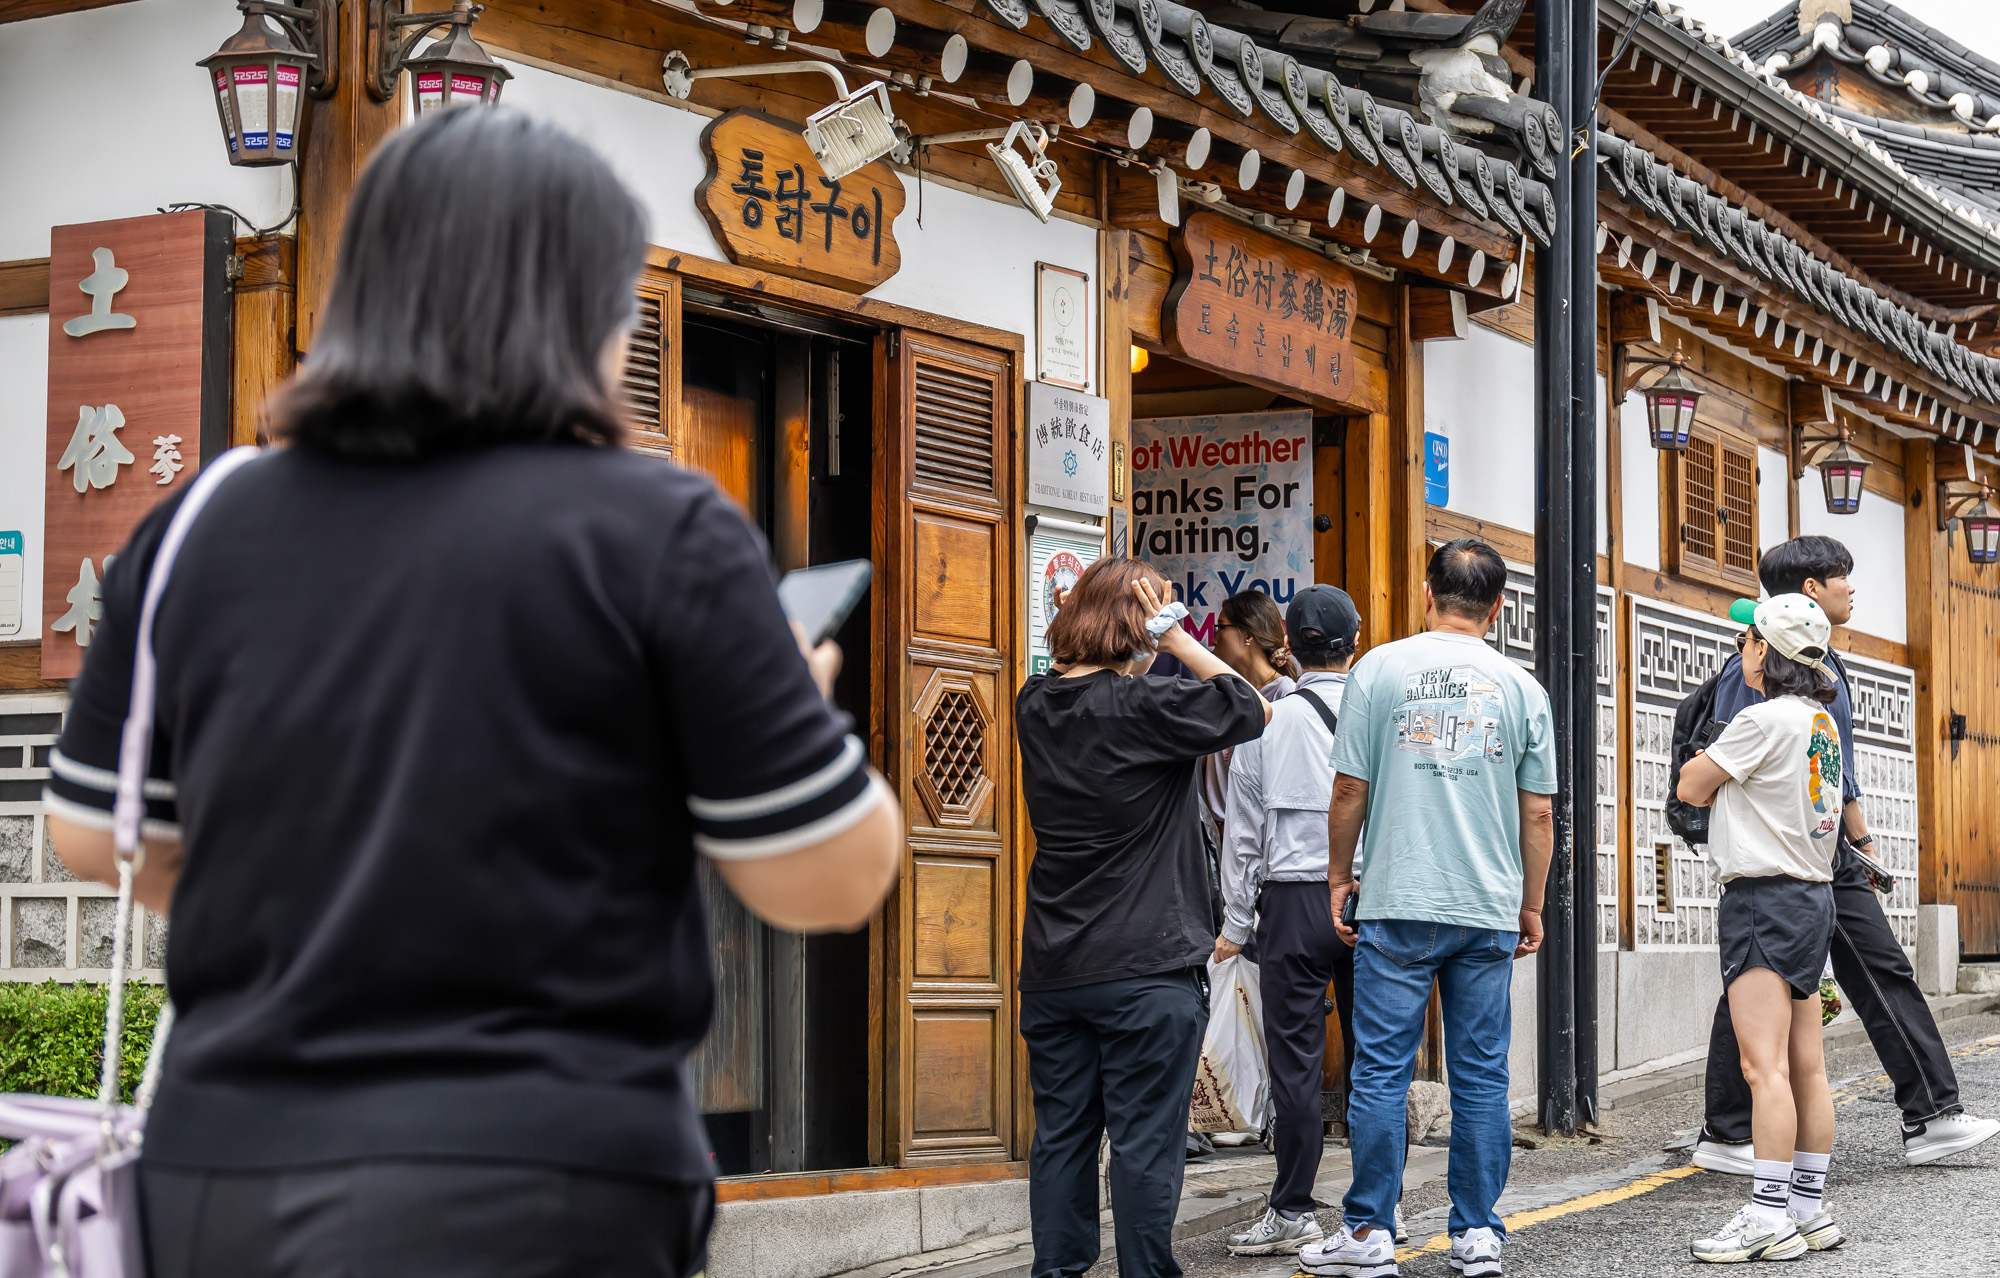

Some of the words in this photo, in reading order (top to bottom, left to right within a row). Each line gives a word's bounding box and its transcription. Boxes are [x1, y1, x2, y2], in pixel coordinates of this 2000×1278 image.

[731, 148, 883, 266] 통닭구이
[149, 434, 184, 485] 蔘
[1132, 439, 1162, 471] ot
[1168, 431, 1305, 469] Weather
[1035, 483, 1060, 497] TRADITIONAL
[1062, 488, 1078, 500] KOREAN
[1079, 491, 1105, 505] RESTAURANT
[1132, 478, 1224, 516] anks
[1233, 475, 1299, 511] For
[1053, 554, 1081, 574] 좋은식단
[1419, 668, 1452, 685] NEW
[1405, 682, 1468, 701] BALANCE
[1432, 770, 1448, 778] SINC
[1466, 769, 1479, 777] USA
